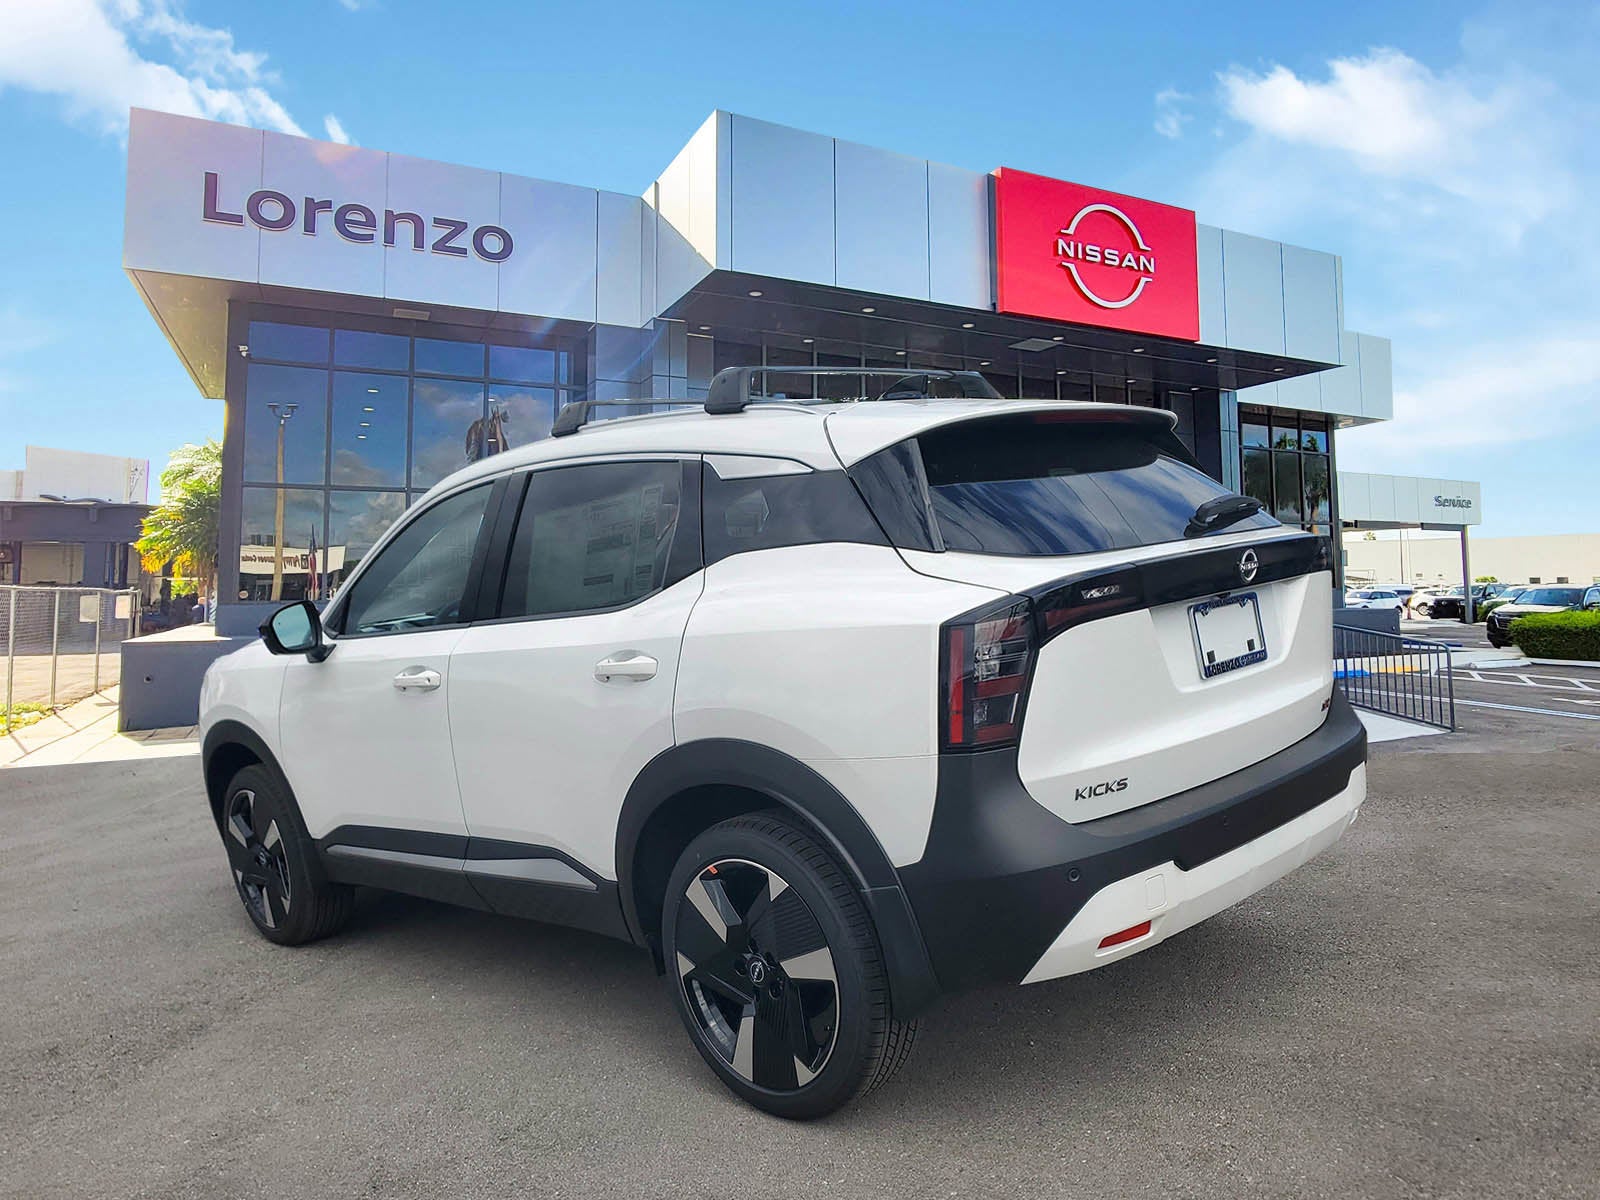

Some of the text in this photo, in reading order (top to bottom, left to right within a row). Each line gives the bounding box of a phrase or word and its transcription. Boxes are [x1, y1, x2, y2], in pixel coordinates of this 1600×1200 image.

[202, 171, 514, 263] Lorenzo
[1057, 238, 1155, 273] NISSAN
[1434, 495, 1472, 509] Service
[1075, 777, 1129, 801] KICKS
